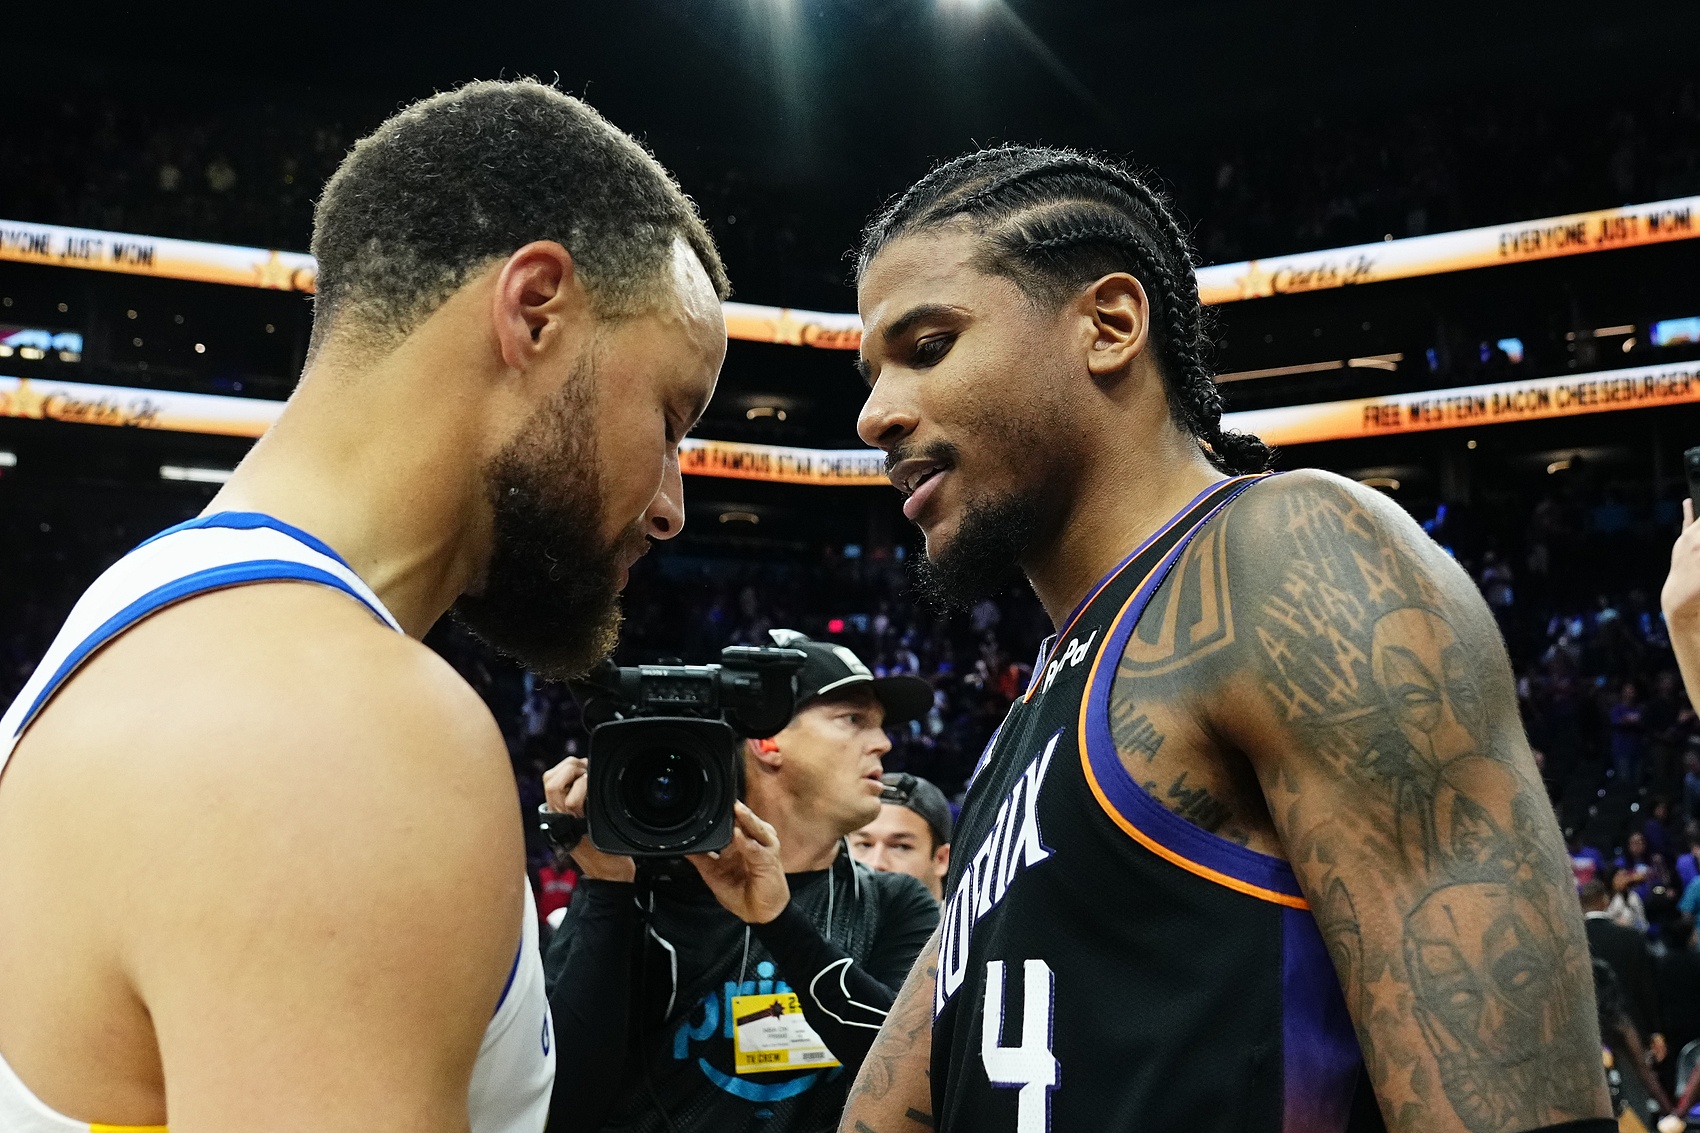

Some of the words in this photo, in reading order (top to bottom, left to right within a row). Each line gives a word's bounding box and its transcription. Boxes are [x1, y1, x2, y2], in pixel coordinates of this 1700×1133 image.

[0, 230, 51, 257] YONE
[60, 236, 103, 260] JUST
[1499, 221, 1587, 257] EVERYONE
[1598, 215, 1639, 244] JUST
[1362, 403, 1401, 428] FREE
[1408, 394, 1487, 424] WESTERN
[1492, 384, 1550, 417] BACON
[712, 447, 770, 474] FAMOUS
[776, 454, 812, 477] STAR
[757, 1052, 780, 1063] CREW
[981, 958, 1061, 1133] 4
